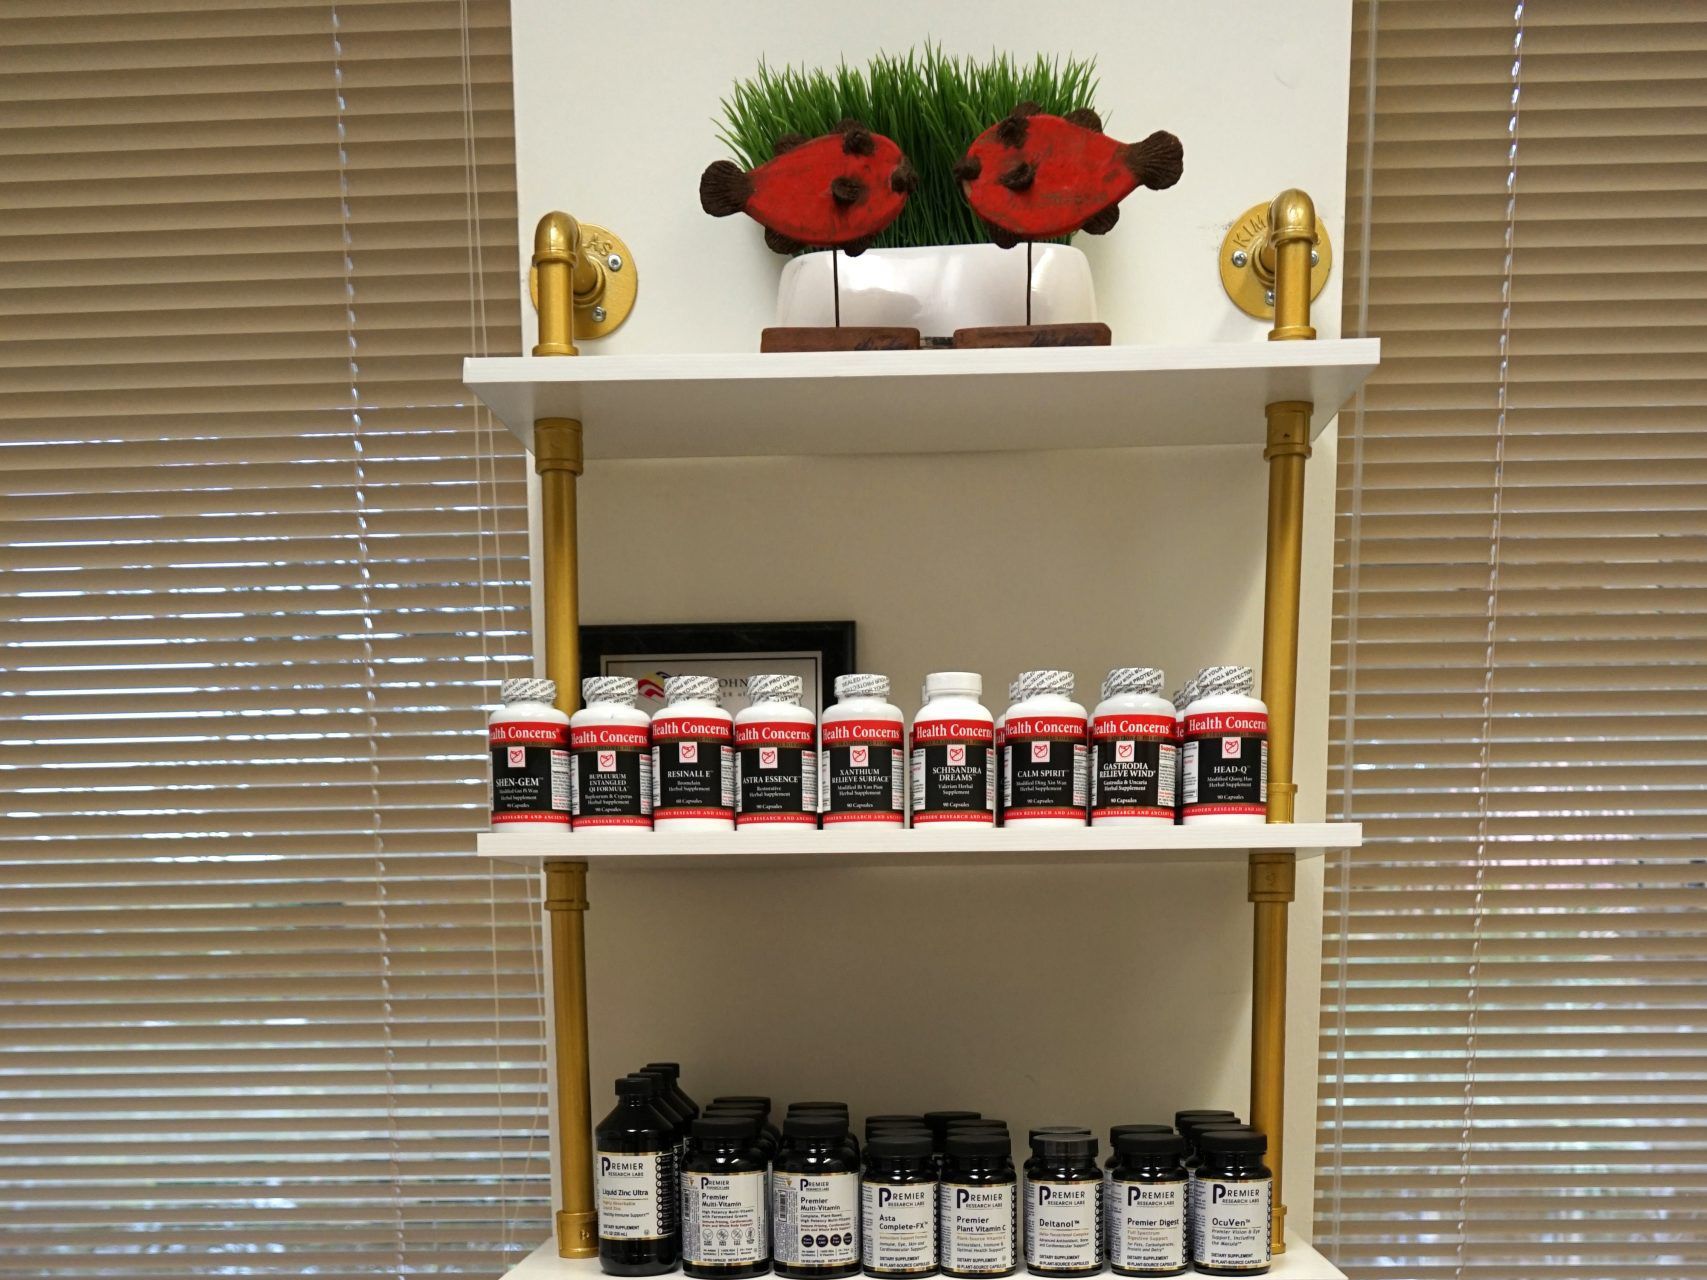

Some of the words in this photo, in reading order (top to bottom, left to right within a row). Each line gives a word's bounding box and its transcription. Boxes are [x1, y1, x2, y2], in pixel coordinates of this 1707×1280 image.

[681, 722, 729, 735] Concerns
[1035, 721, 1082, 733] Concerns
[1120, 721, 1169, 734] Concerns
[1189, 718, 1222, 731] Health
[490, 727, 506, 740] ealth
[600, 731, 647, 743] Concerns
[762, 727, 810, 740] Concerns
[853, 726, 899, 739] Concerns
[917, 726, 947, 738] Health
[668, 770, 703, 778] RESINALL
[1017, 770, 1039, 778] CALM
[1100, 770, 1128, 778] RELIEVE
[1129, 770, 1154, 778] WIND
[1214, 766, 1247, 774] HEAD-Q
[743, 776, 763, 784] ASTRA
[602, 1157, 643, 1176] PREMIER
[701, 1177, 729, 1189] PREMIER
[800, 1179, 829, 1191] PREMIER
[879, 1188, 925, 1207] PREMIER
[957, 1189, 1002, 1208] PREMIER
[1039, 1186, 1085, 1205] PREMIER
[1128, 1186, 1174, 1206] PREMIER
[1213, 1184, 1259, 1204] PREMIER
[957, 1216, 989, 1224] Premier
[1128, 1218, 1157, 1226] Premier
[1160, 1218, 1179, 1227] Digest
